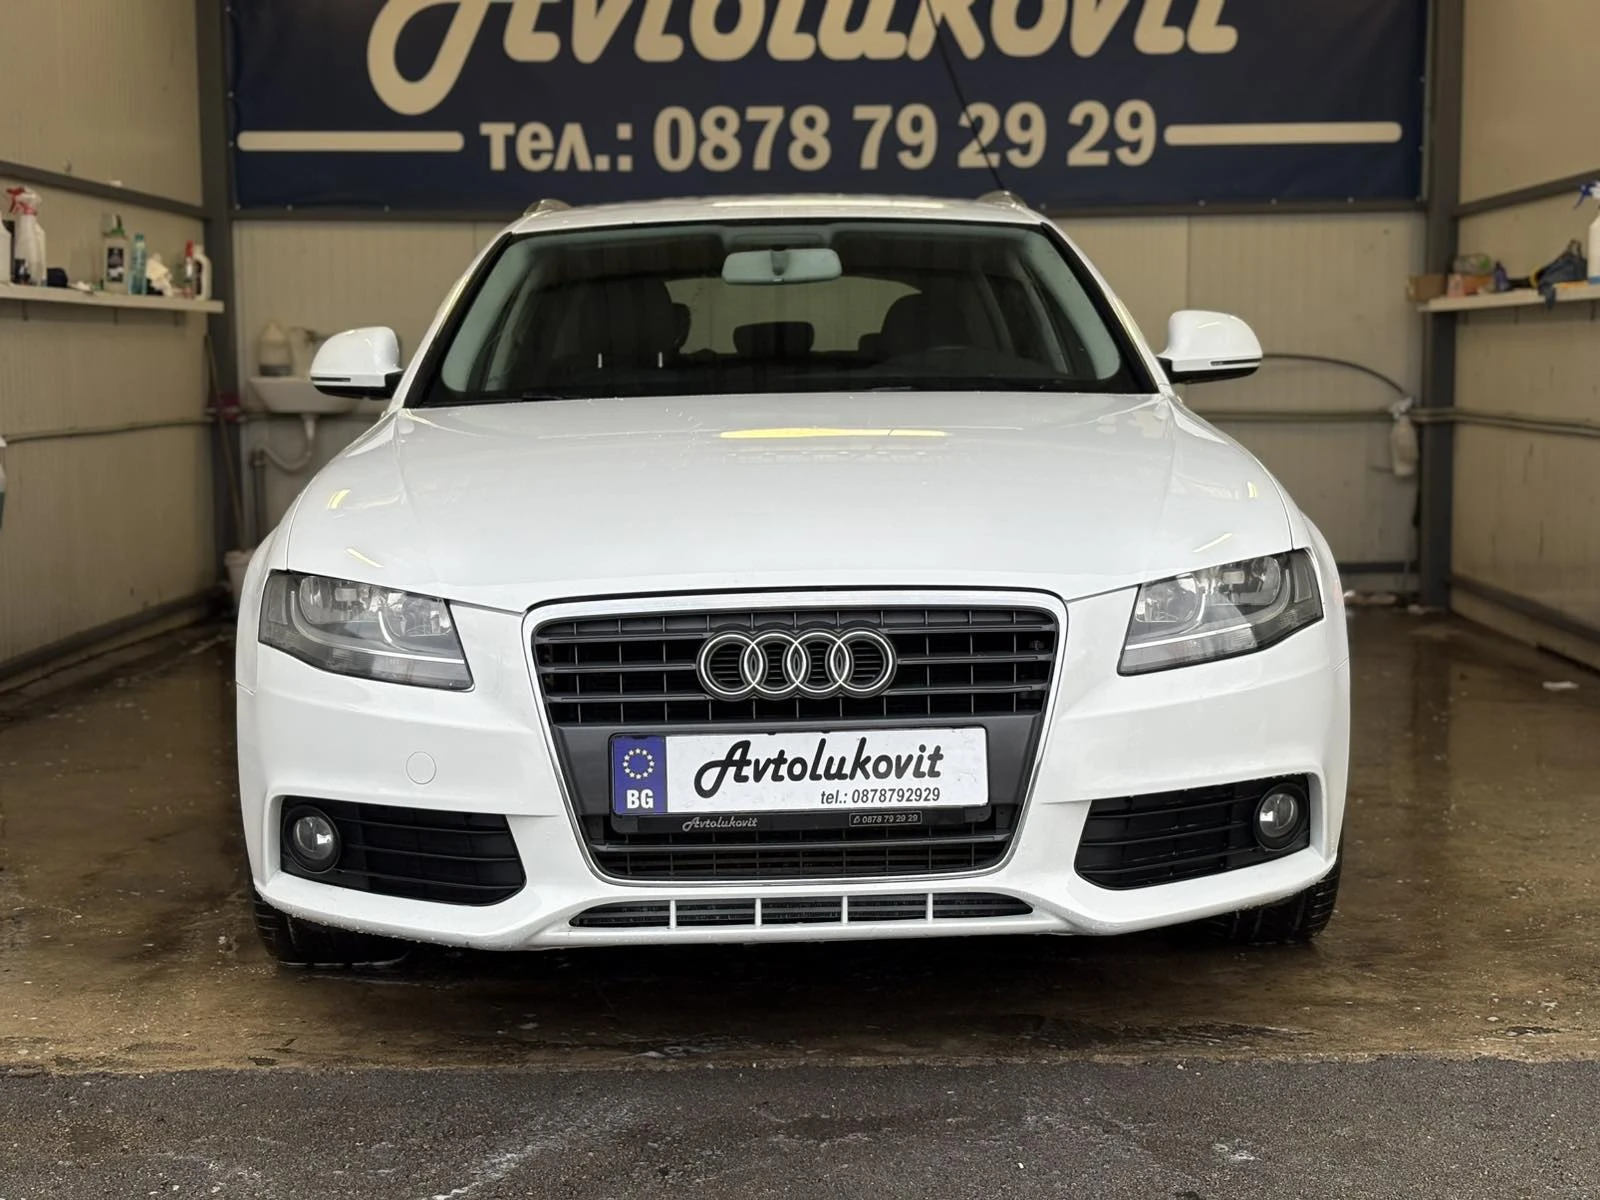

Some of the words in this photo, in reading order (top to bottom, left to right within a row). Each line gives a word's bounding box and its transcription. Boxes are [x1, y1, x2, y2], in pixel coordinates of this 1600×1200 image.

[479, 121, 633, 172] тел.:
[653, 105, 831, 172] 0878
[852, 103, 938, 170] 79
[957, 102, 1047, 168] 29
[1066, 99, 1157, 167] 29
[693, 736, 945, 799] Avtolukovit
[626, 788, 654, 810] BG
[820, 790, 848, 805] tel.:
[851, 787, 941, 804] 0878792929
[681, 815, 758, 832] Avtolukovit
[861, 815, 882, 824] 0878
[895, 814, 906, 822] 29
[908, 814, 918, 822] 29
